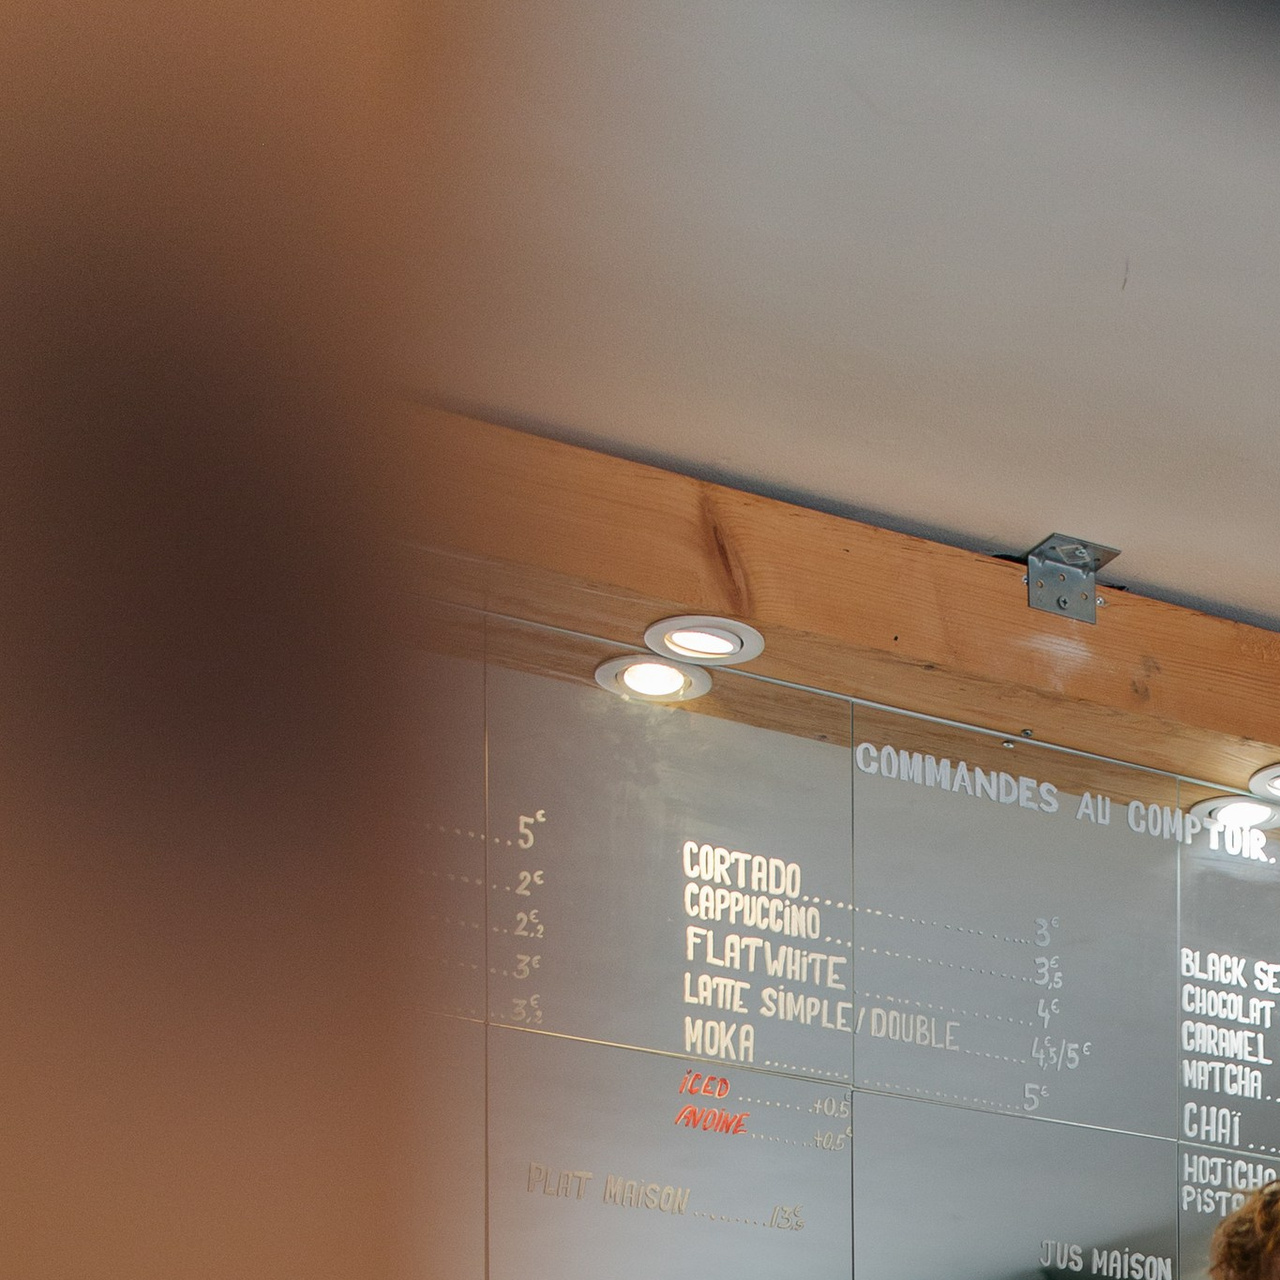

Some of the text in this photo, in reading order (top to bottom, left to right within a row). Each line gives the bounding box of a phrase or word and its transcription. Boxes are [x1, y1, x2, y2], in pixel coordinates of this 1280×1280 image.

[855, 742, 1059, 814] COMMANDES
[1076, 791, 1111, 826] AU
[682, 840, 801, 899] CORTADO
[1181, 947, 1248, 988] BLACK
[683, 971, 751, 1014] LATTE
[1181, 983, 1276, 1029] CHOCOLAT
[684, 1016, 755, 1063] MOKA
[1181, 1020, 1273, 1066] CARAMEL
[1181, 1059, 1263, 1100] MATCHA
[526, 1161, 594, 1200] PLAT
[1039, 1239, 1084, 1272] JUS
